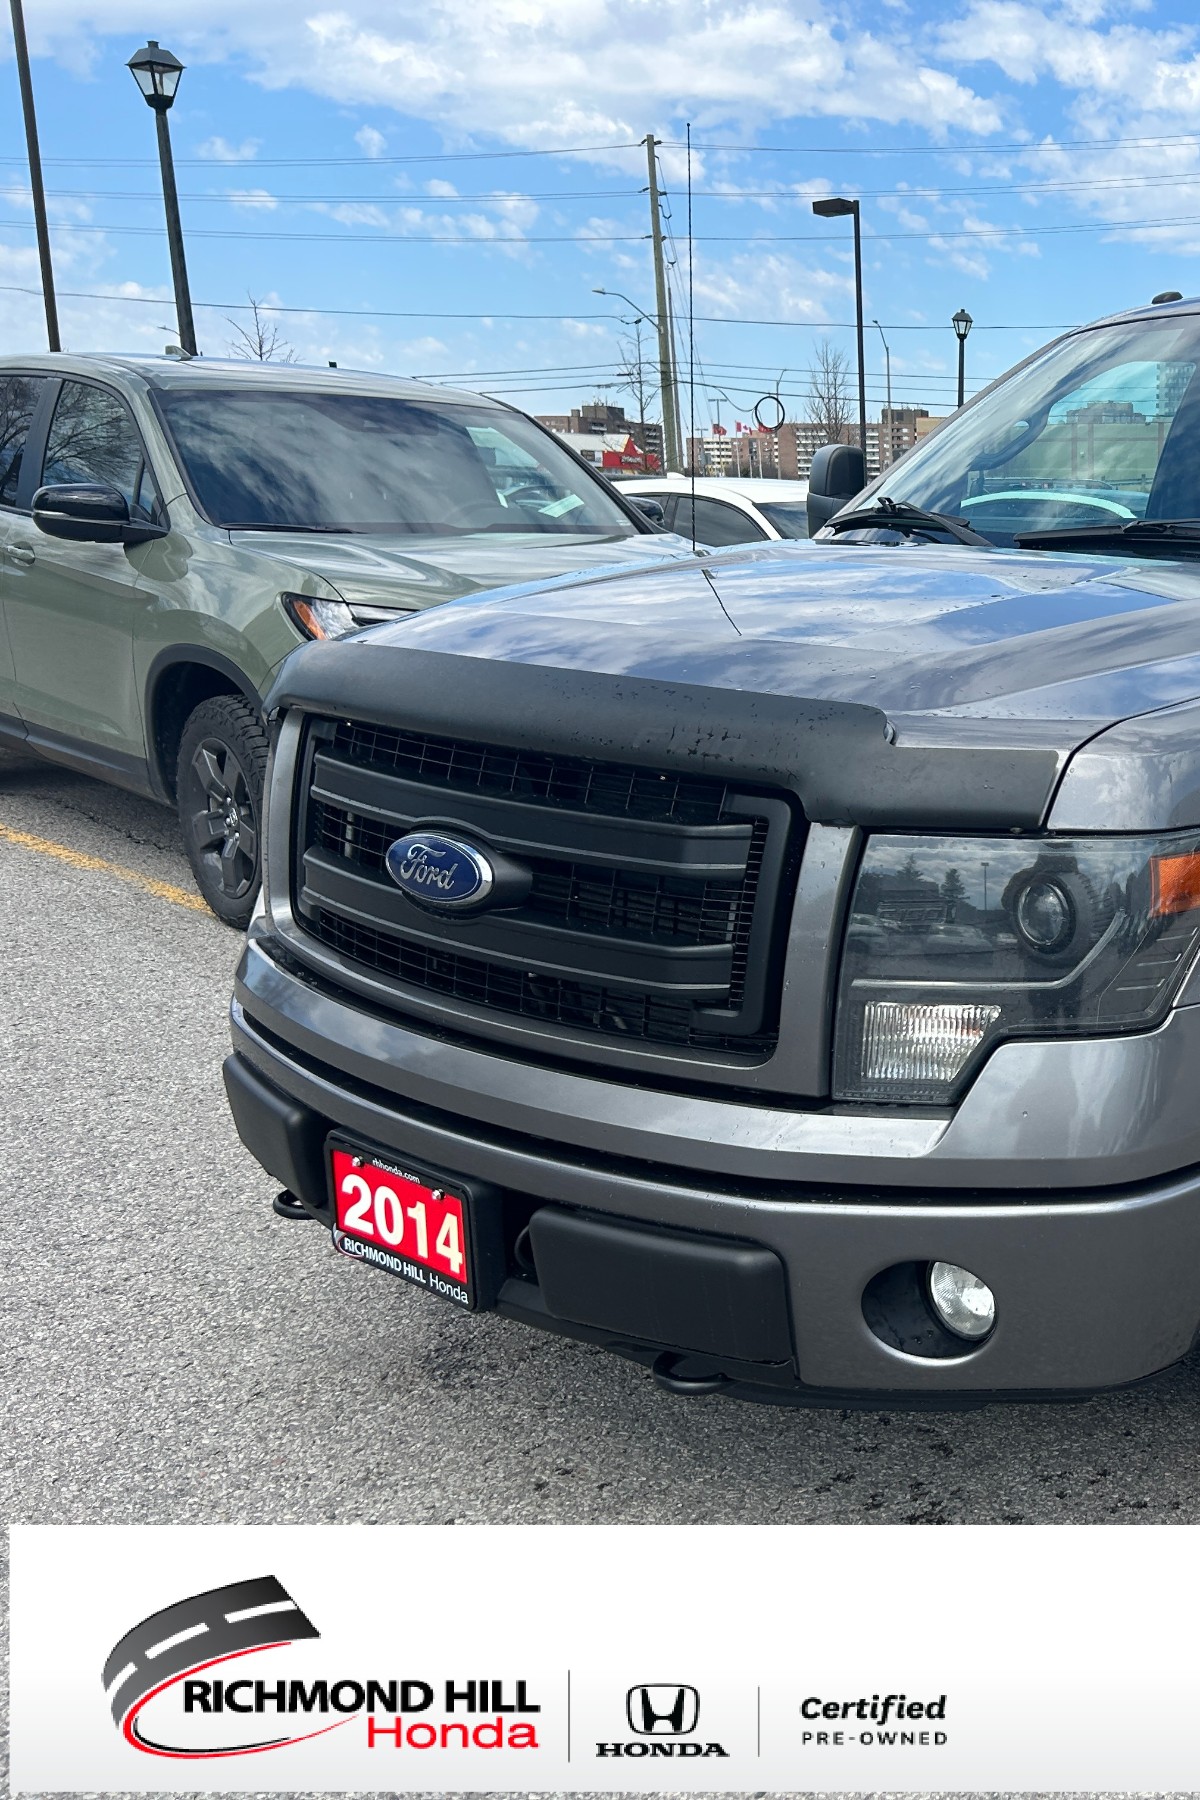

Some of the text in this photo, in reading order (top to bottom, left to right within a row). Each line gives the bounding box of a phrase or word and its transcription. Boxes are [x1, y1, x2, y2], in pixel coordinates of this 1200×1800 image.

[400, 843, 458, 890] Ford
[341, 1173, 463, 1274] 2014
[344, 1237, 469, 1304] RICHMOND HILL Honda
